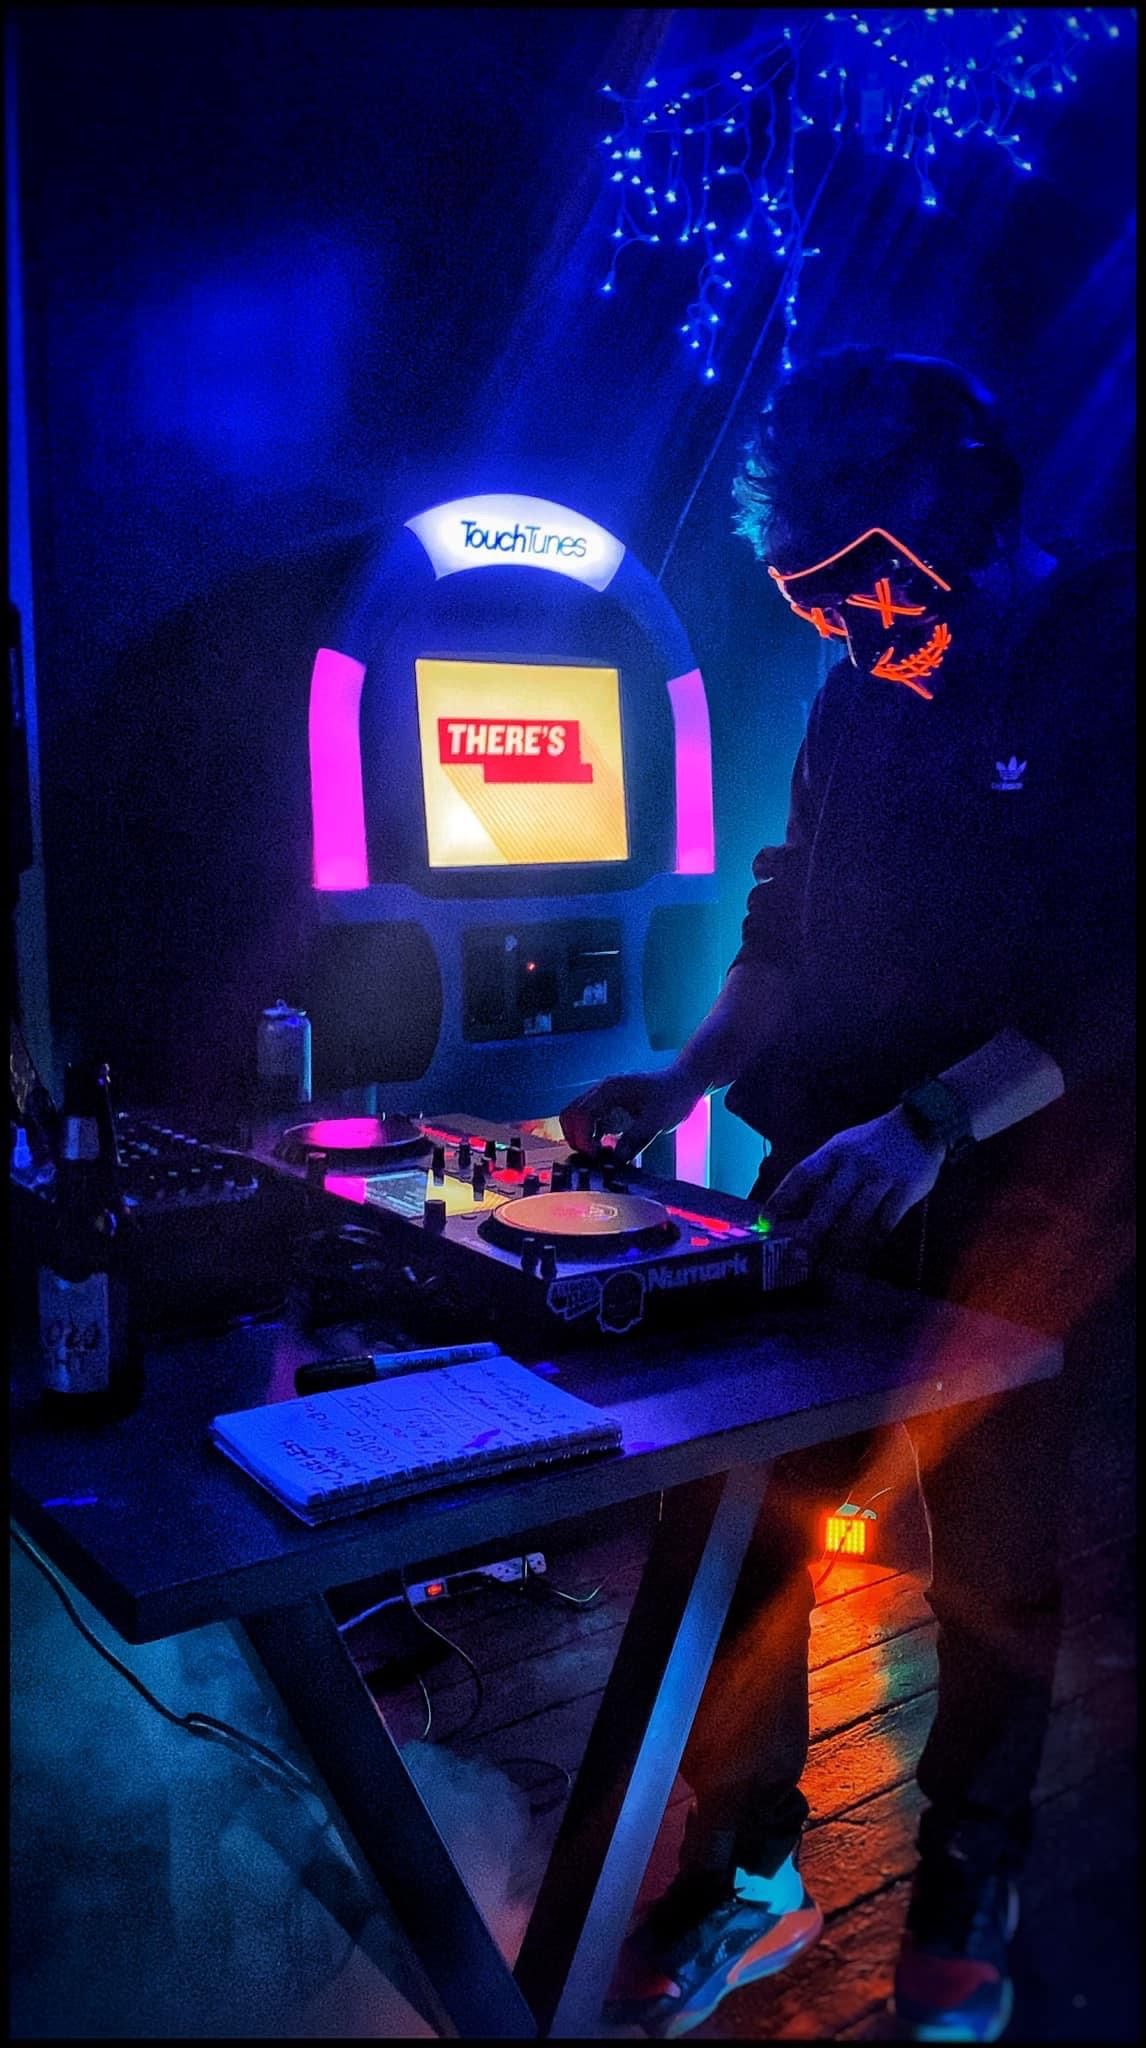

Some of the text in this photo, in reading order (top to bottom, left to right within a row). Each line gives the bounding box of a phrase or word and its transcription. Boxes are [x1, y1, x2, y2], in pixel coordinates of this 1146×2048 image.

[461, 520, 587, 558] TouchTunes
[448, 723, 567, 757] THERE'S
[649, 1253, 747, 1289] Numark
